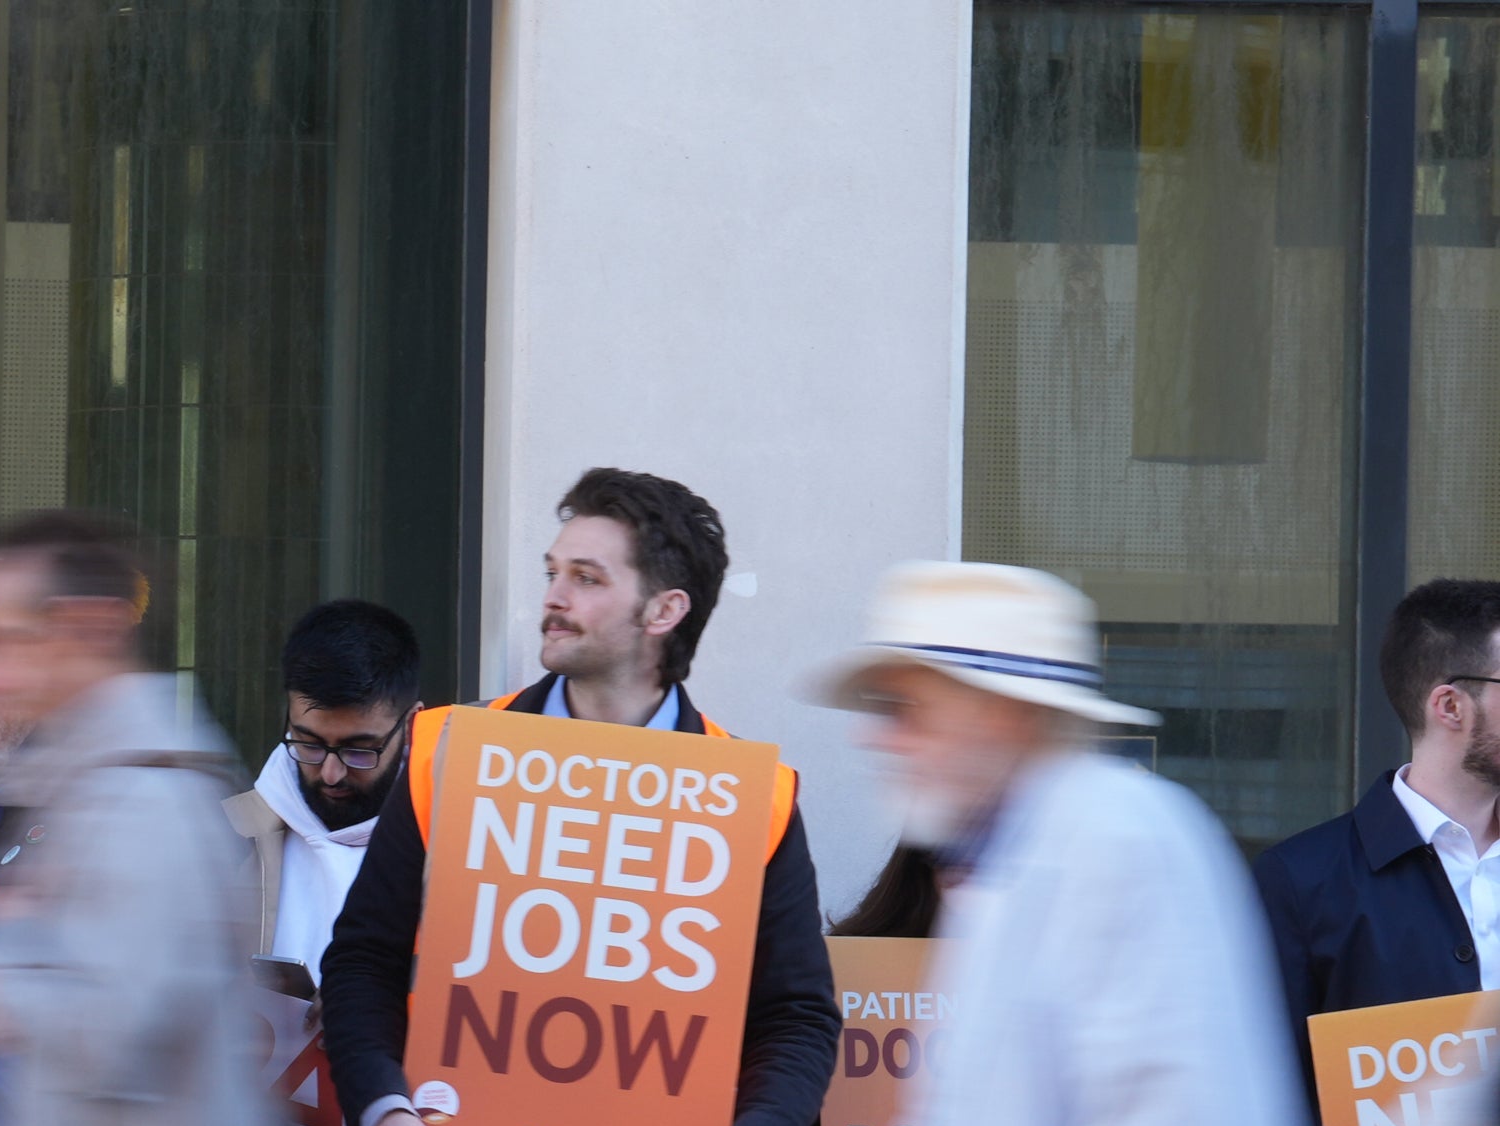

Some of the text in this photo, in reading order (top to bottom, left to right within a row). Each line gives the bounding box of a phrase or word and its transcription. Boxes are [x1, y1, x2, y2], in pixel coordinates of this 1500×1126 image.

[476, 743, 741, 817] DOCTORS
[465, 796, 731, 897] NEED
[452, 882, 722, 993] JOBS
[439, 983, 709, 1097] NOW
[841, 991, 959, 1020] PATIEN
[1347, 1027, 1497, 1090] DOCT
